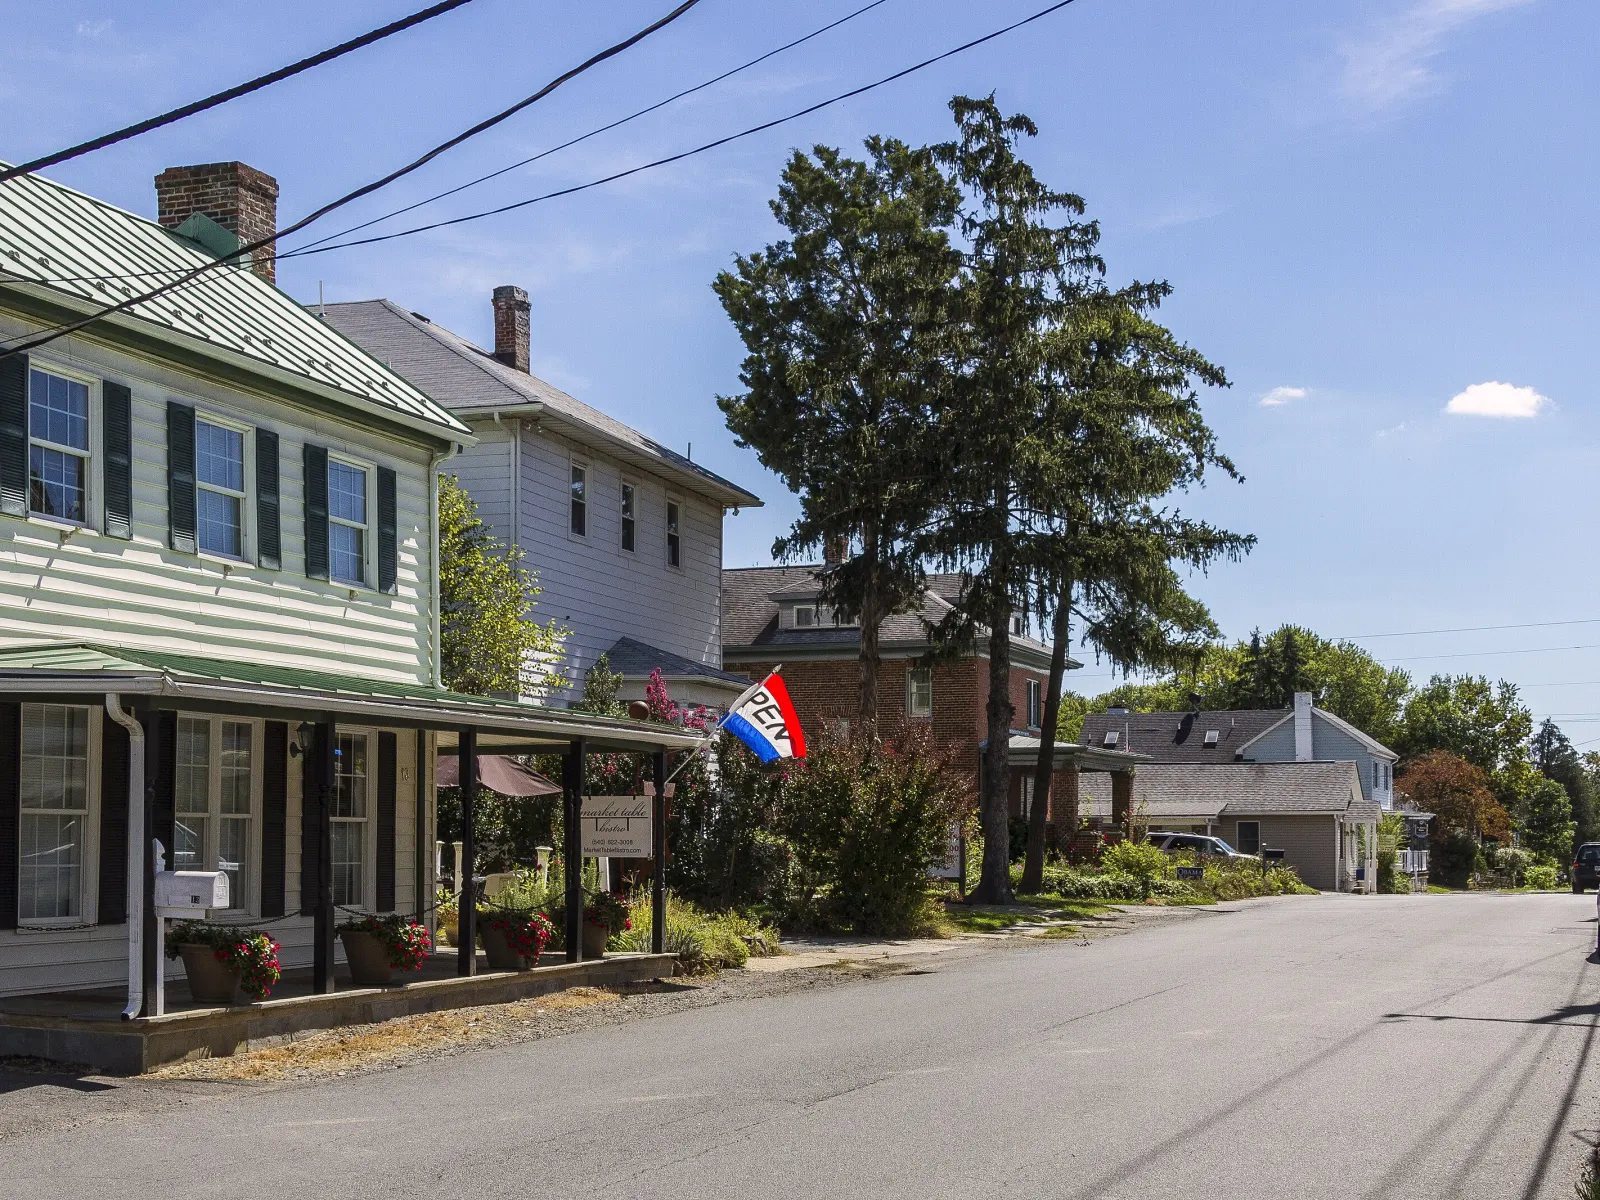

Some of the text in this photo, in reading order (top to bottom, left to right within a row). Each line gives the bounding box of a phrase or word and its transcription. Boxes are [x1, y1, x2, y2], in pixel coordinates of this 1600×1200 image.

[580, 801, 647, 817] market table
[599, 819, 626, 833] bistro
